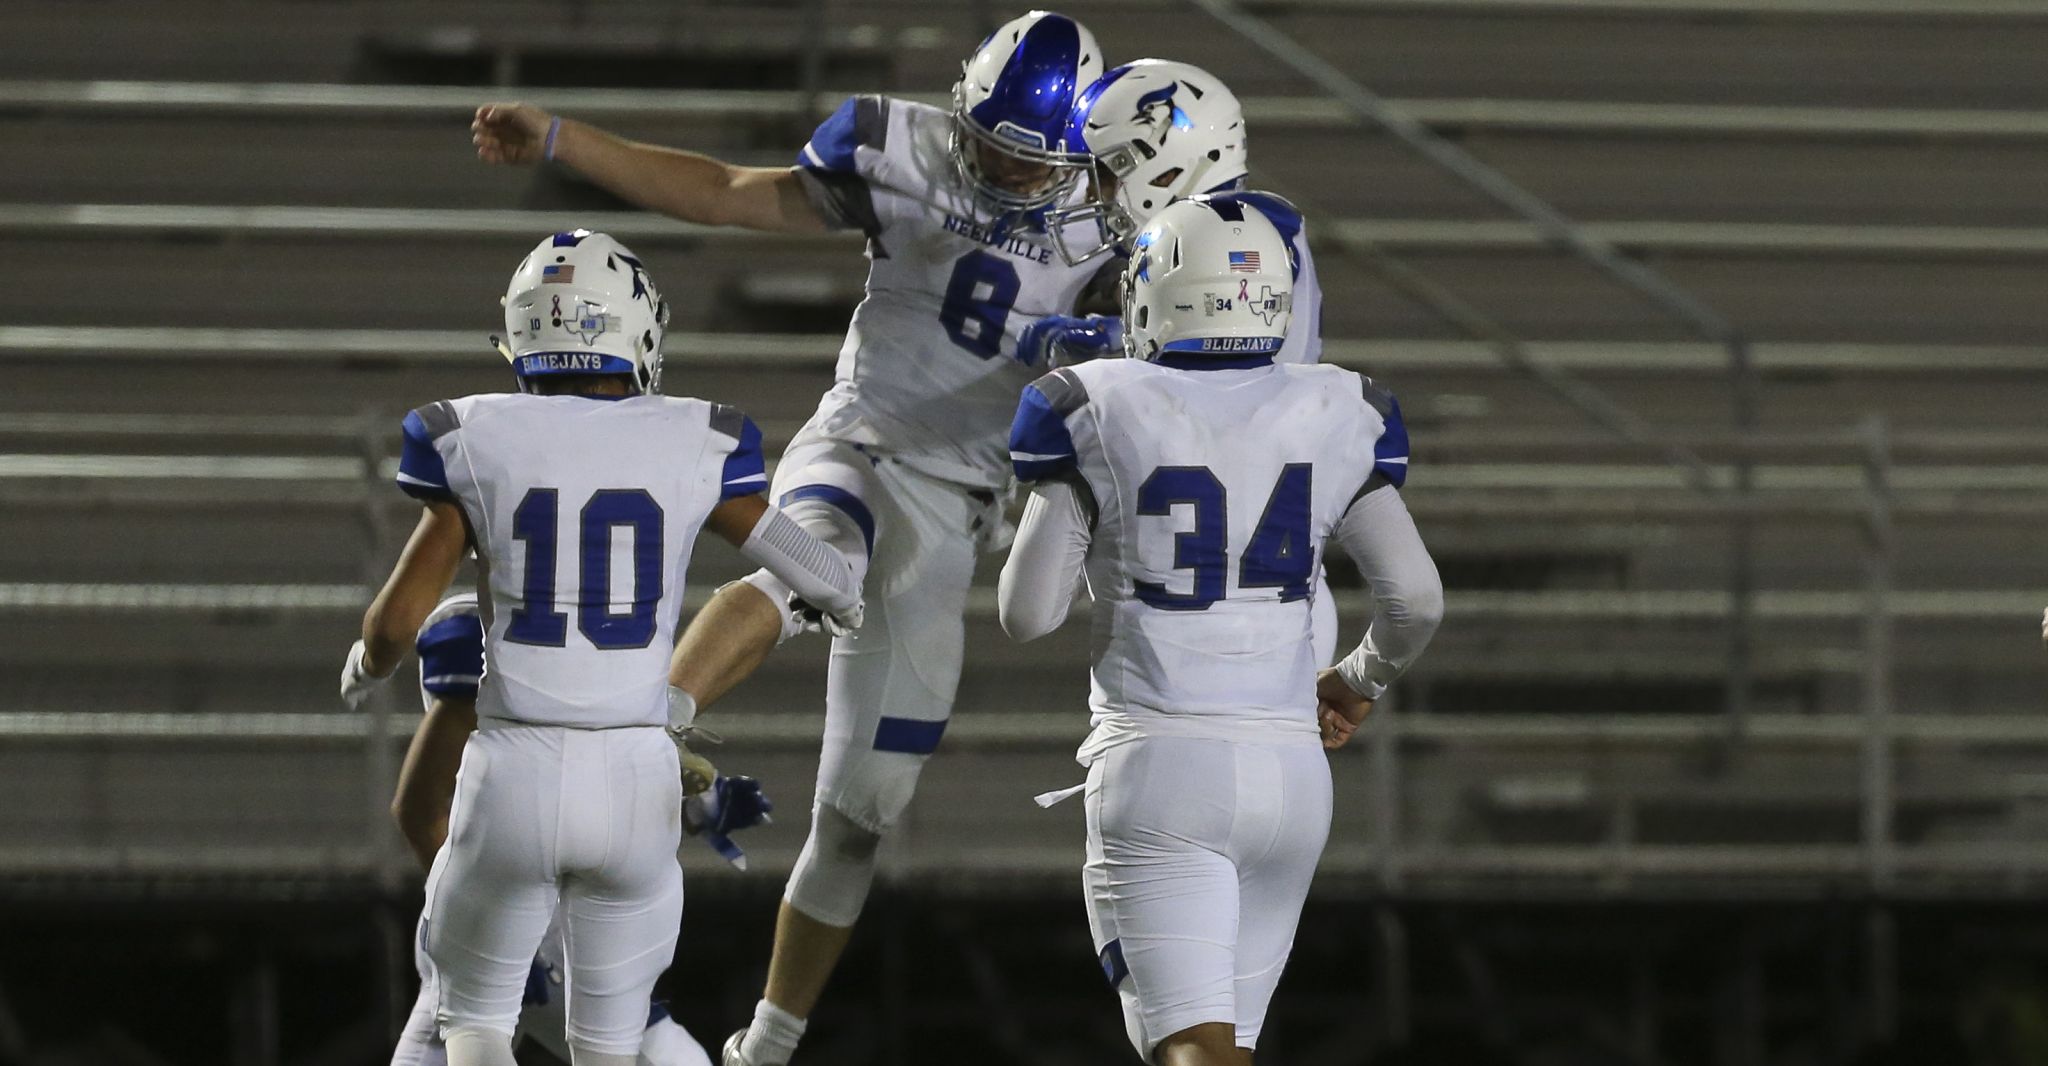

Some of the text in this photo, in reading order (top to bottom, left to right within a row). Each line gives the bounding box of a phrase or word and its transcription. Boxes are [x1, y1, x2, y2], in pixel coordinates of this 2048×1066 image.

[938, 249, 1021, 361] 8
[1216, 299, 1232, 311] 34
[530, 318, 541, 331] 10
[1203, 338, 1273, 351] BLUEJAYS
[522, 355, 602, 371] BLUEJAYS
[1133, 462, 1316, 611] 34
[503, 487, 664, 650] 10
